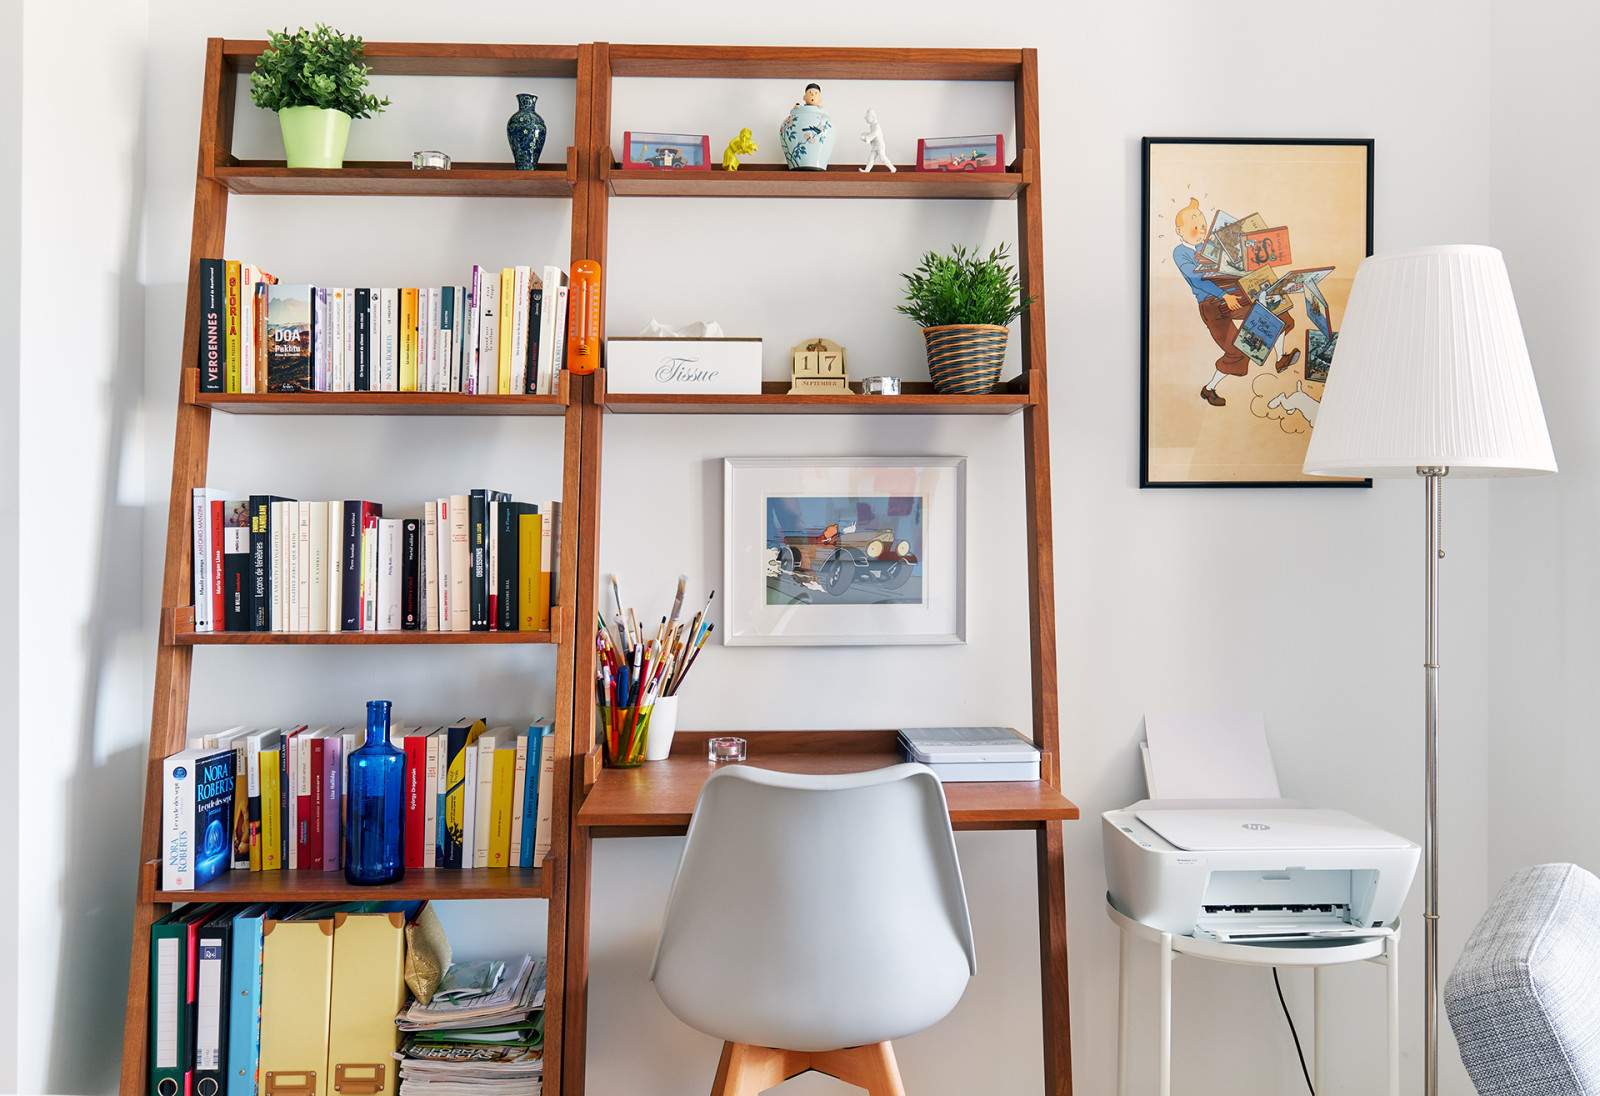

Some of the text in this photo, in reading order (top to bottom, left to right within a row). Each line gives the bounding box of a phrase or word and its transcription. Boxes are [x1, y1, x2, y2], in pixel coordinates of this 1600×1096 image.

[208, 313, 218, 382] VERGENNES
[275, 330, 300, 342] DOA
[655, 356, 718, 382] Tissue
[802, 356, 836, 372] 1 7
[255, 542, 264, 568] ténèbres
[255, 576, 264, 597] Leçons
[204, 763, 228, 784] NORA
[197, 776, 234, 802] ROBERTS
[198, 804, 204, 813] Le
[223, 795, 232, 803] sept
[169, 838, 179, 866] NORA
[178, 831, 188, 873] ROBERTS
